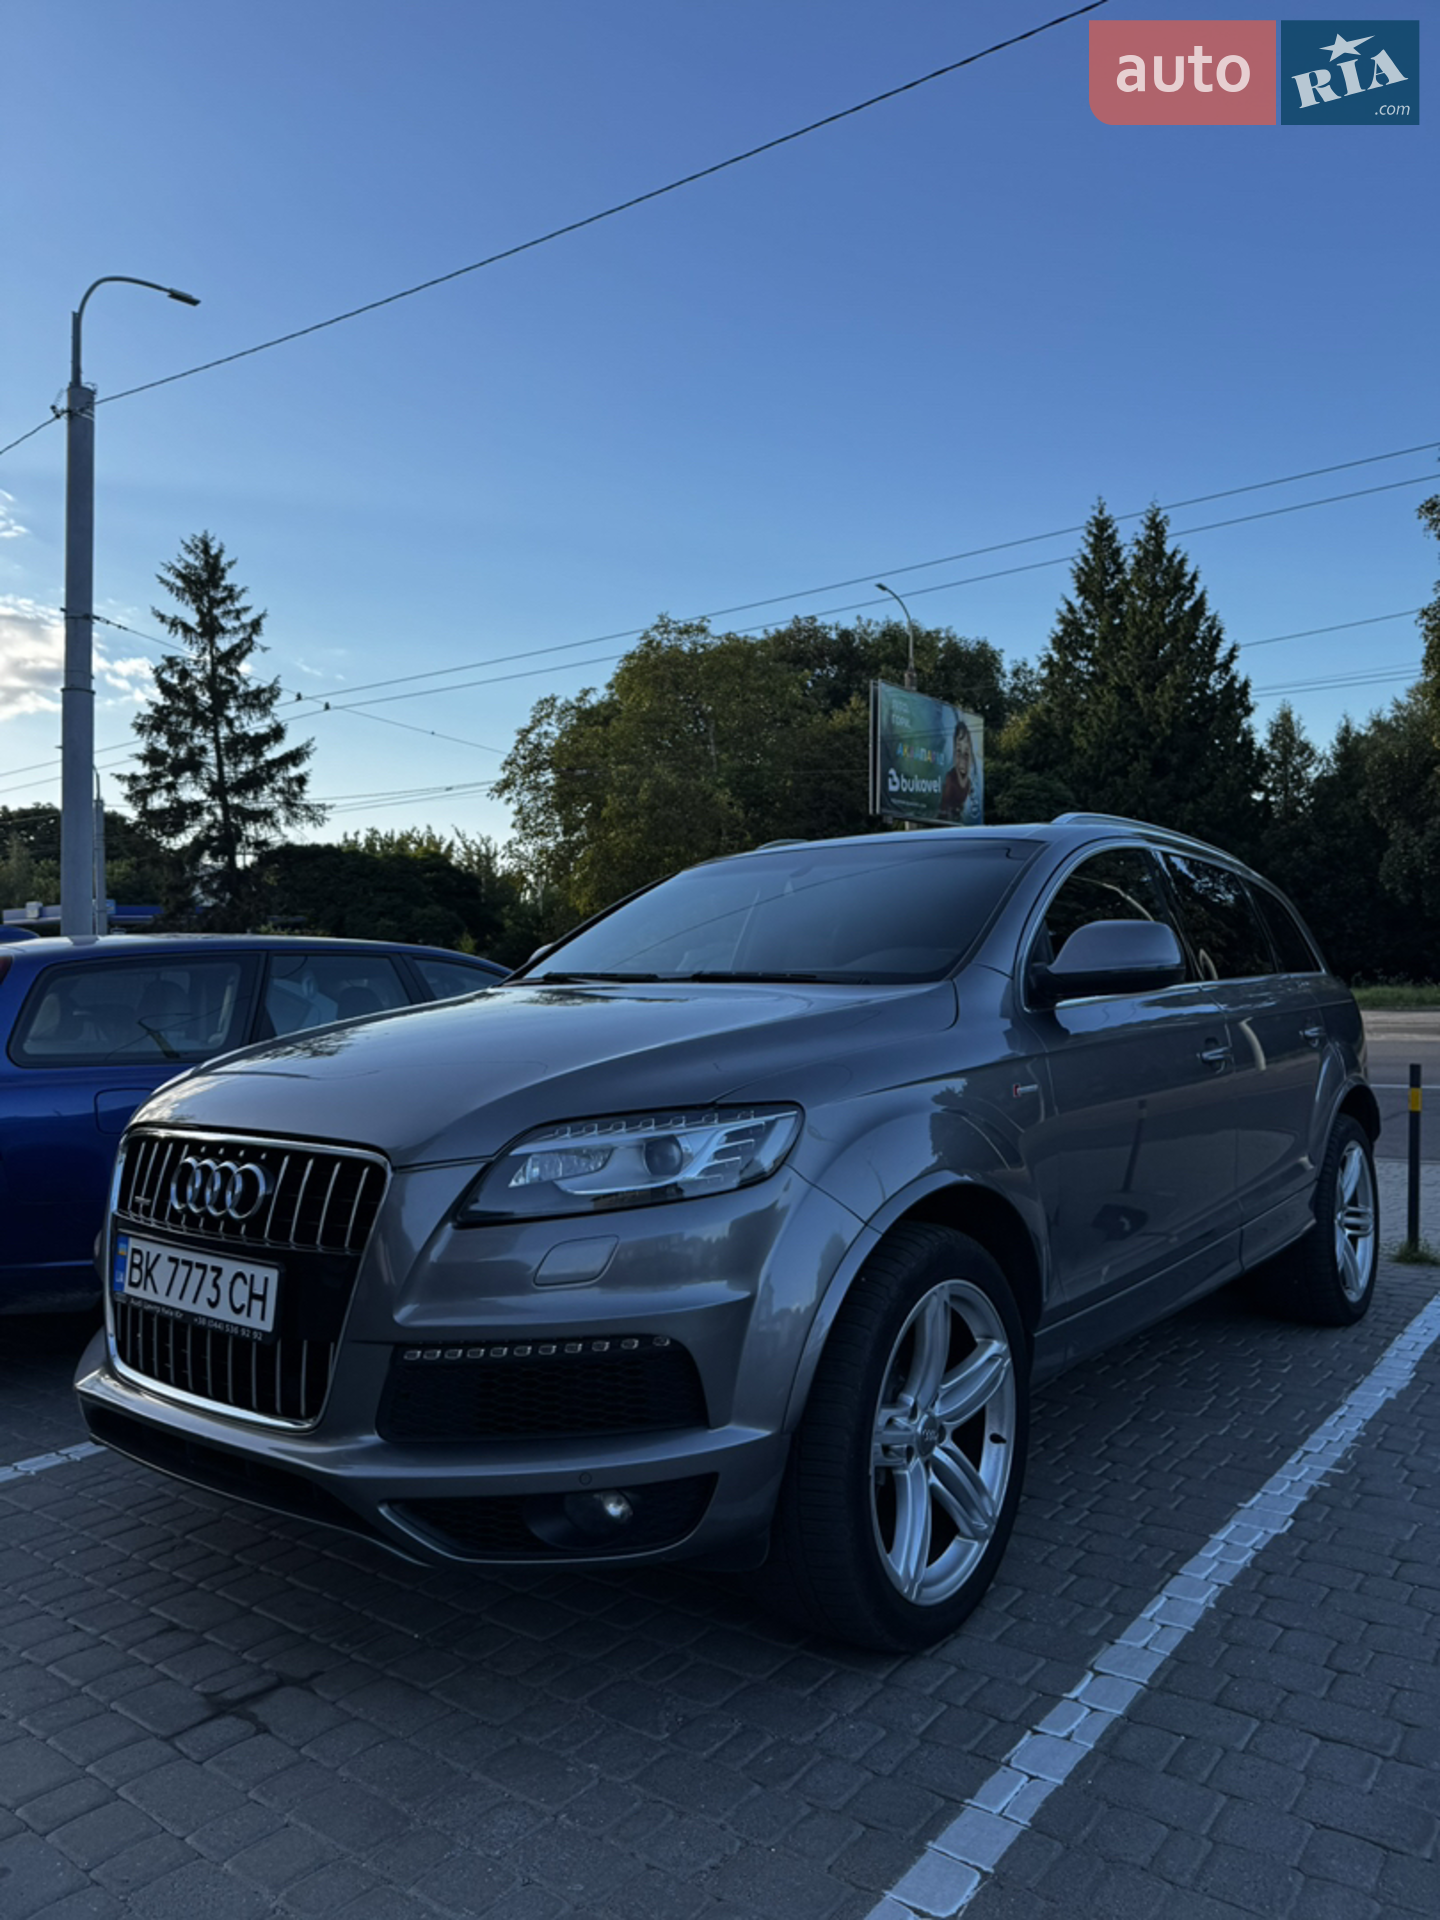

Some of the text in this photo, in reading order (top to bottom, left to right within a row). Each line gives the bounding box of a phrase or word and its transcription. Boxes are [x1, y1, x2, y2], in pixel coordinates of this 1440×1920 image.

[900, 774, 941, 794] bukovel
[128, 1247, 269, 1322] BK 7773 CH
